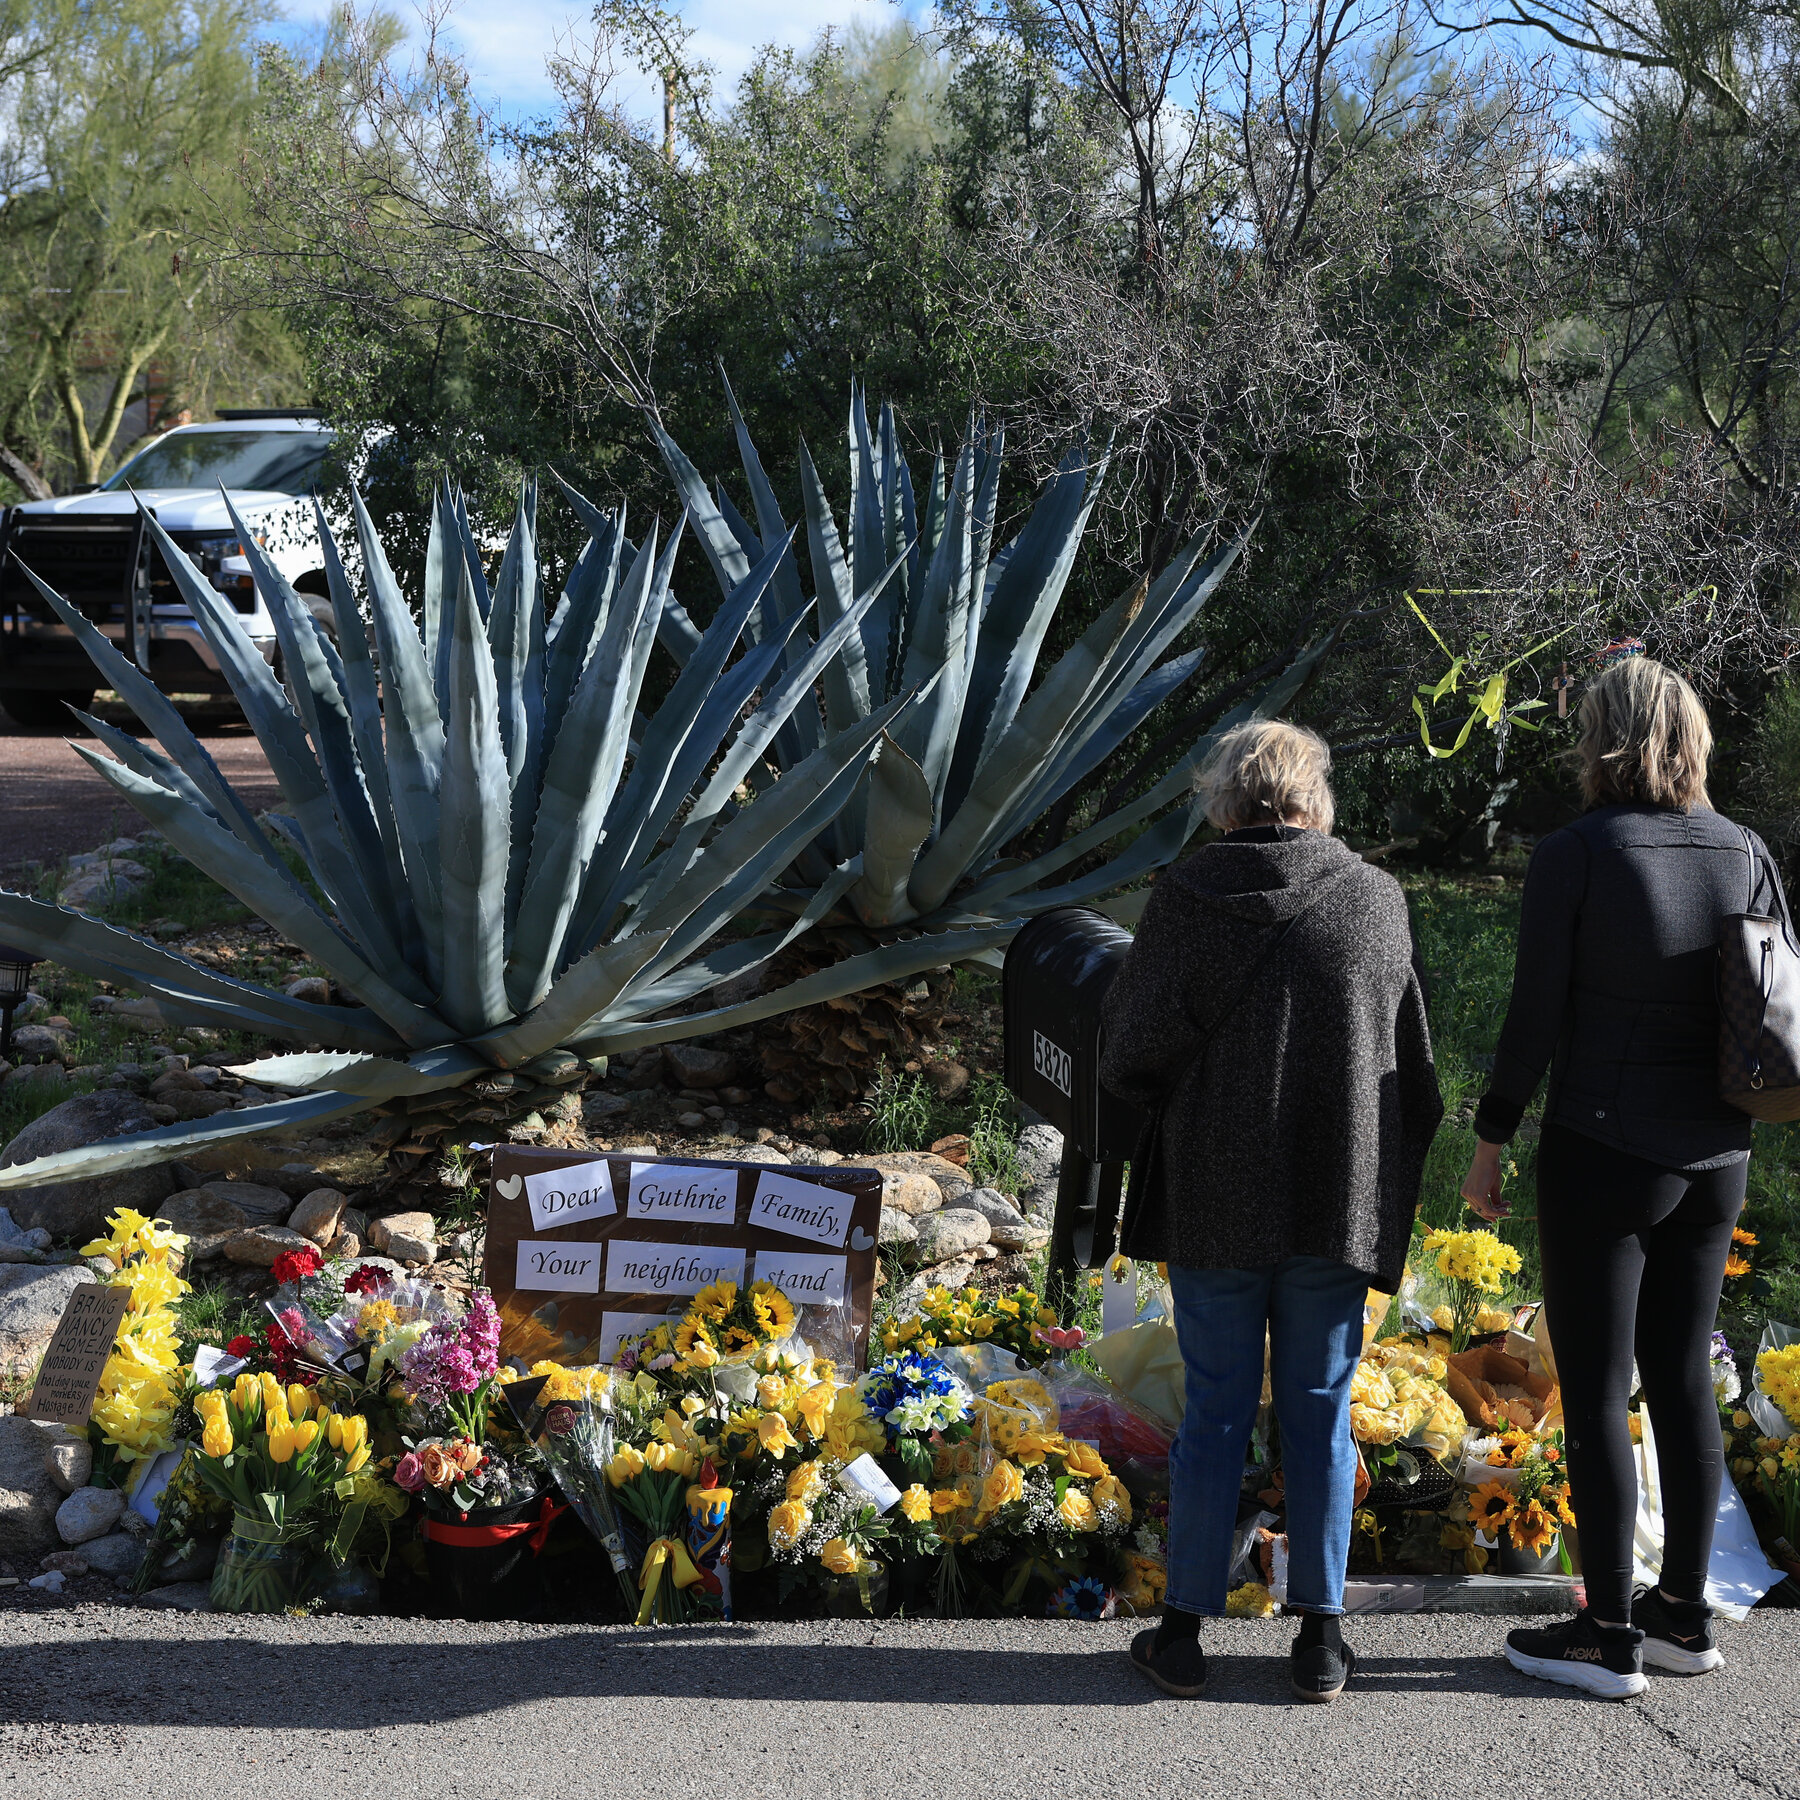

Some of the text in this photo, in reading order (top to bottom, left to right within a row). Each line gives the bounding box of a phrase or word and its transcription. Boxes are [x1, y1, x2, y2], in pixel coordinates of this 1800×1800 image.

[1036, 1033, 1070, 1093] 5820
[542, 1184, 840, 1236] Dear Guthrie Family,
[531, 1250, 834, 1291] Your neighbor stand
[74, 1294, 117, 1314] BRING
[58, 1317, 112, 1336] NANCY
[46, 1356, 98, 1373] NOBODY IS
[1563, 1647, 1603, 1661] HOKA
